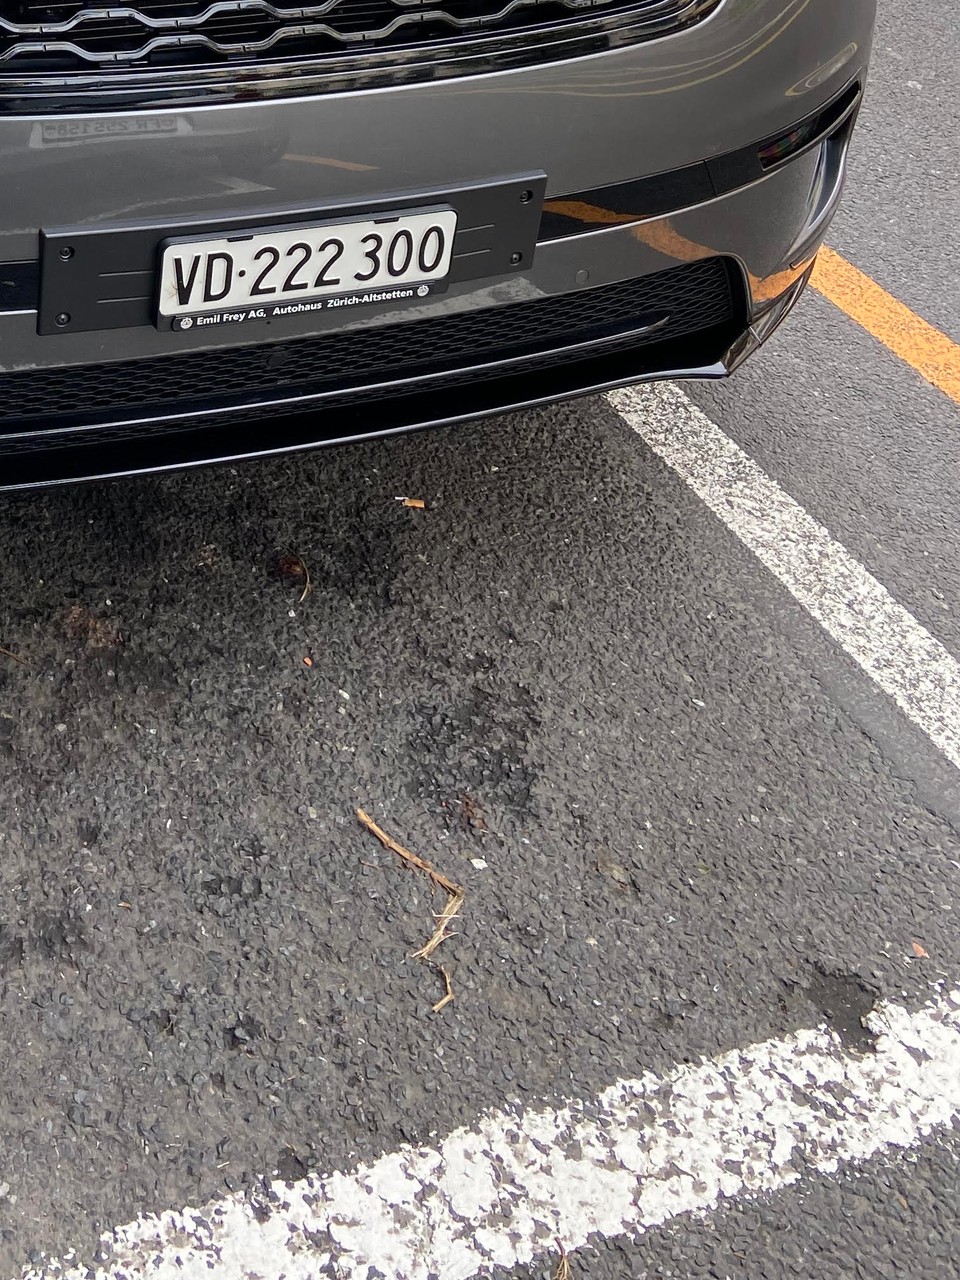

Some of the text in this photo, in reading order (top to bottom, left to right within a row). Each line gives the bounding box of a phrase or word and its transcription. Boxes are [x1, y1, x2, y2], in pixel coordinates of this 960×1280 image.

[197, 288, 413, 326] Emil Frey AG, Autohaus Zürich-Altstetten
